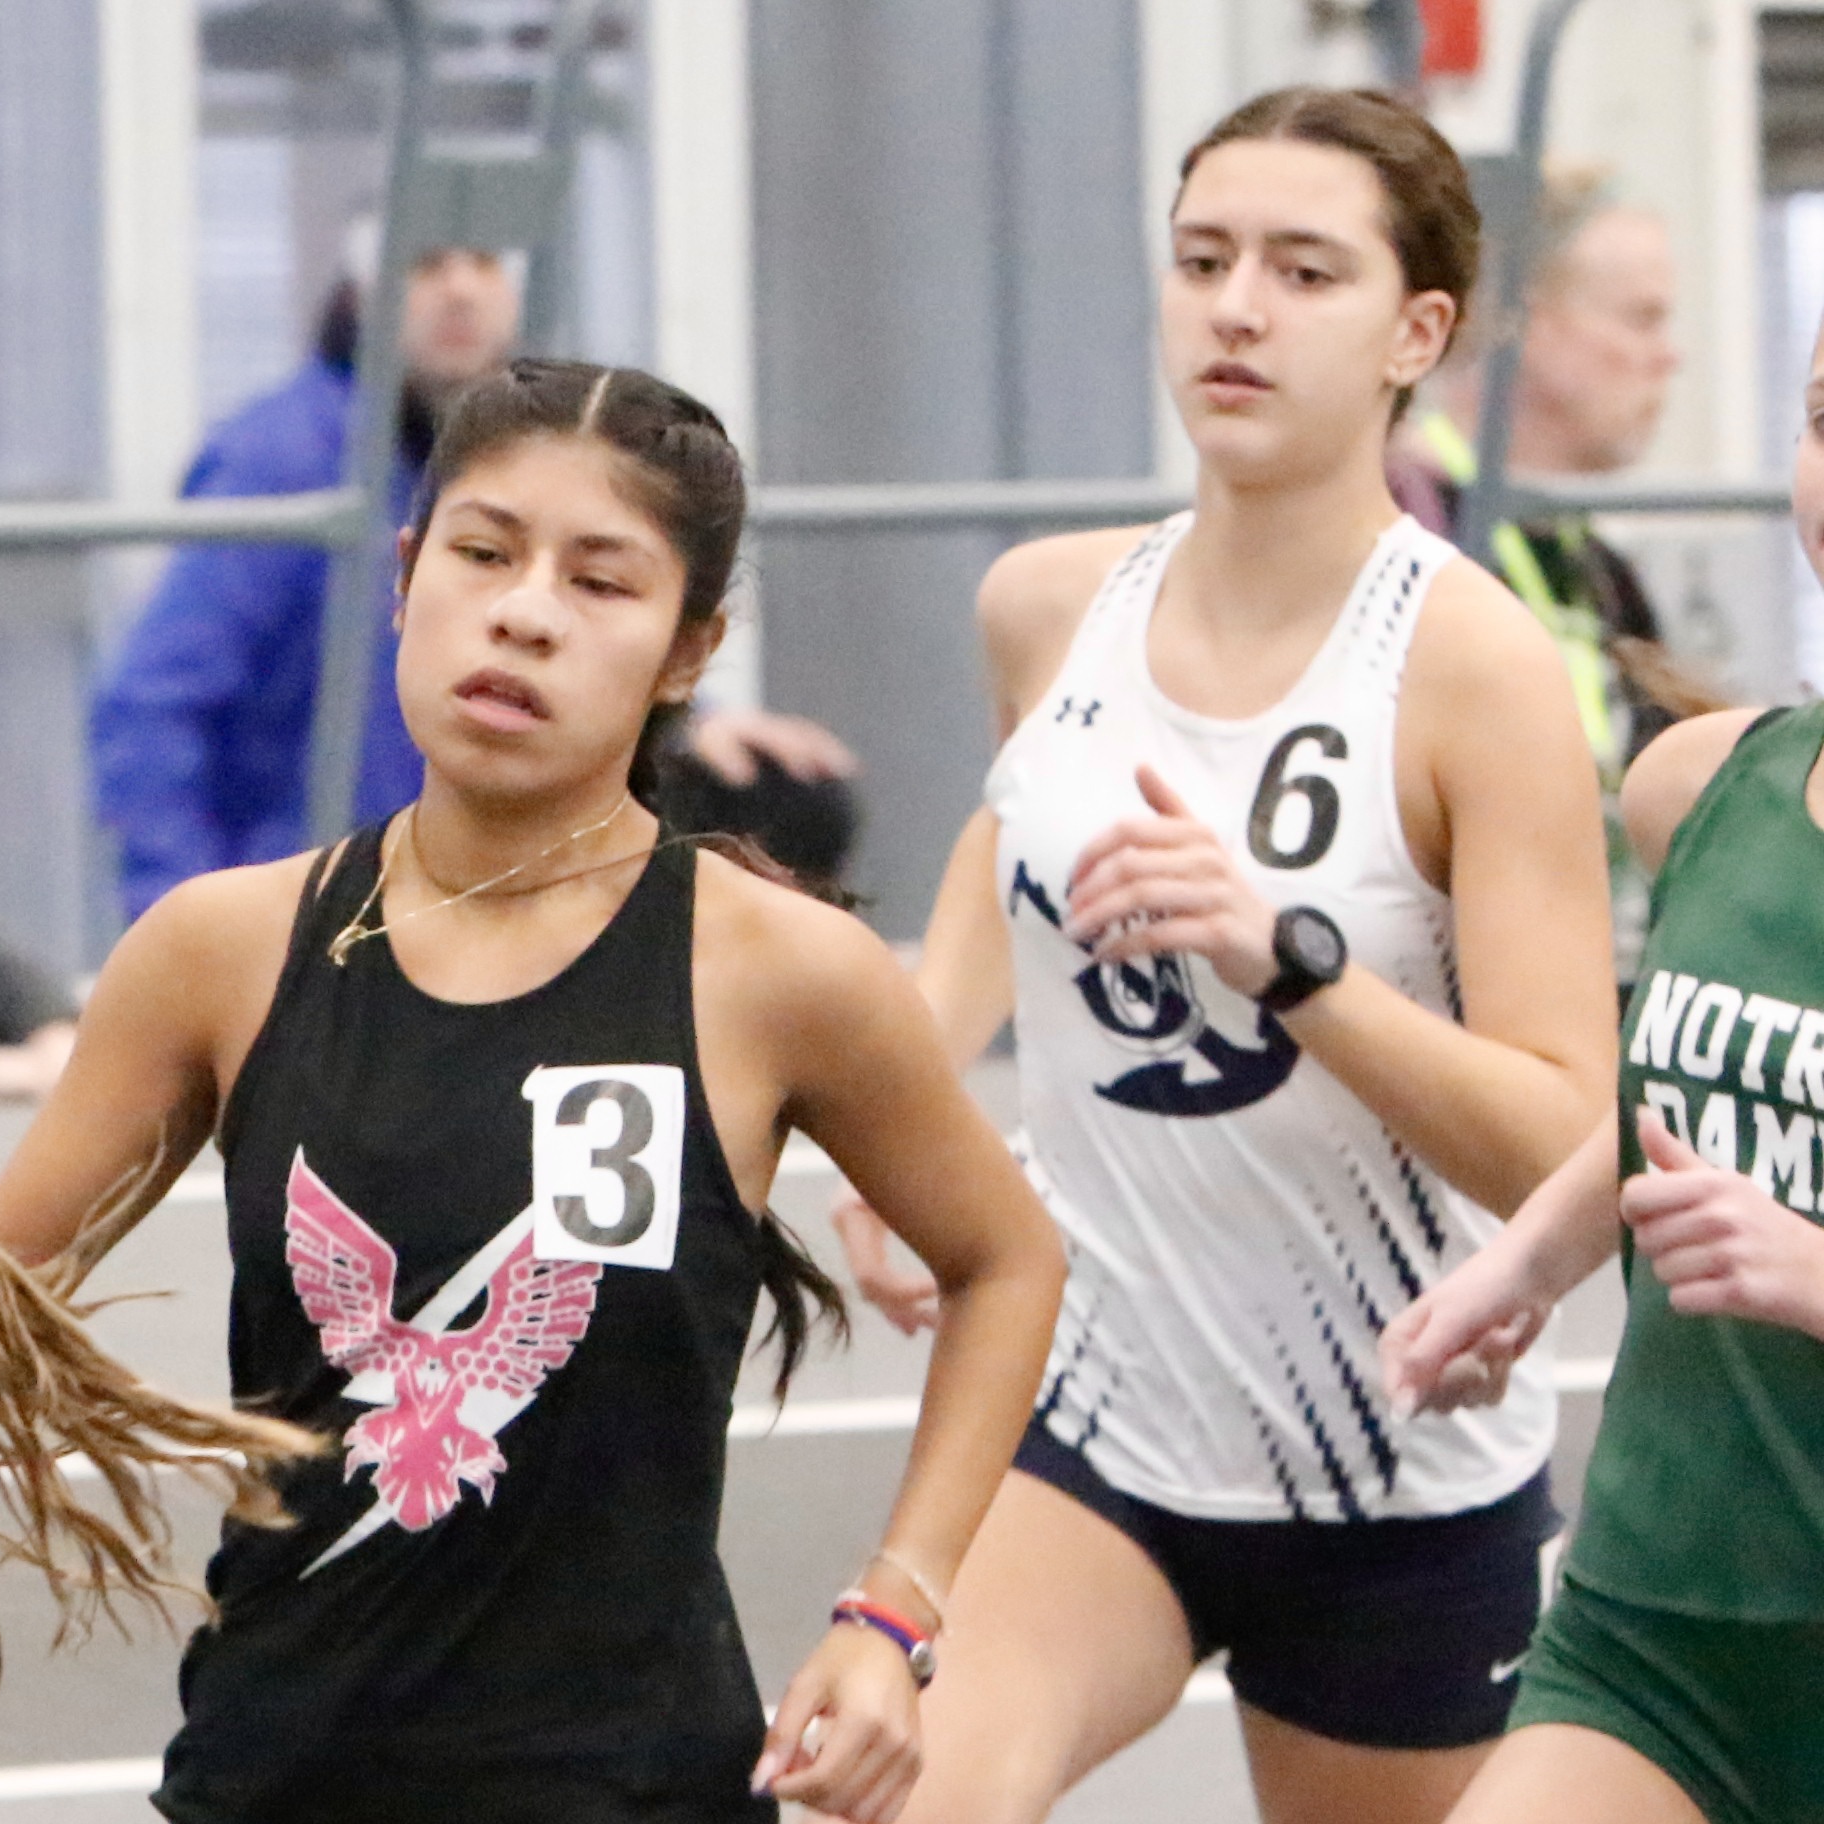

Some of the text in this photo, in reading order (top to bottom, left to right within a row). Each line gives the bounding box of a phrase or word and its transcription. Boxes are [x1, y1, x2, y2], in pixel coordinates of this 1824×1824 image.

[1248, 723, 1348, 869] 6
[552, 1079, 655, 1247] 3
[1644, 1080, 1824, 1217] DAM
